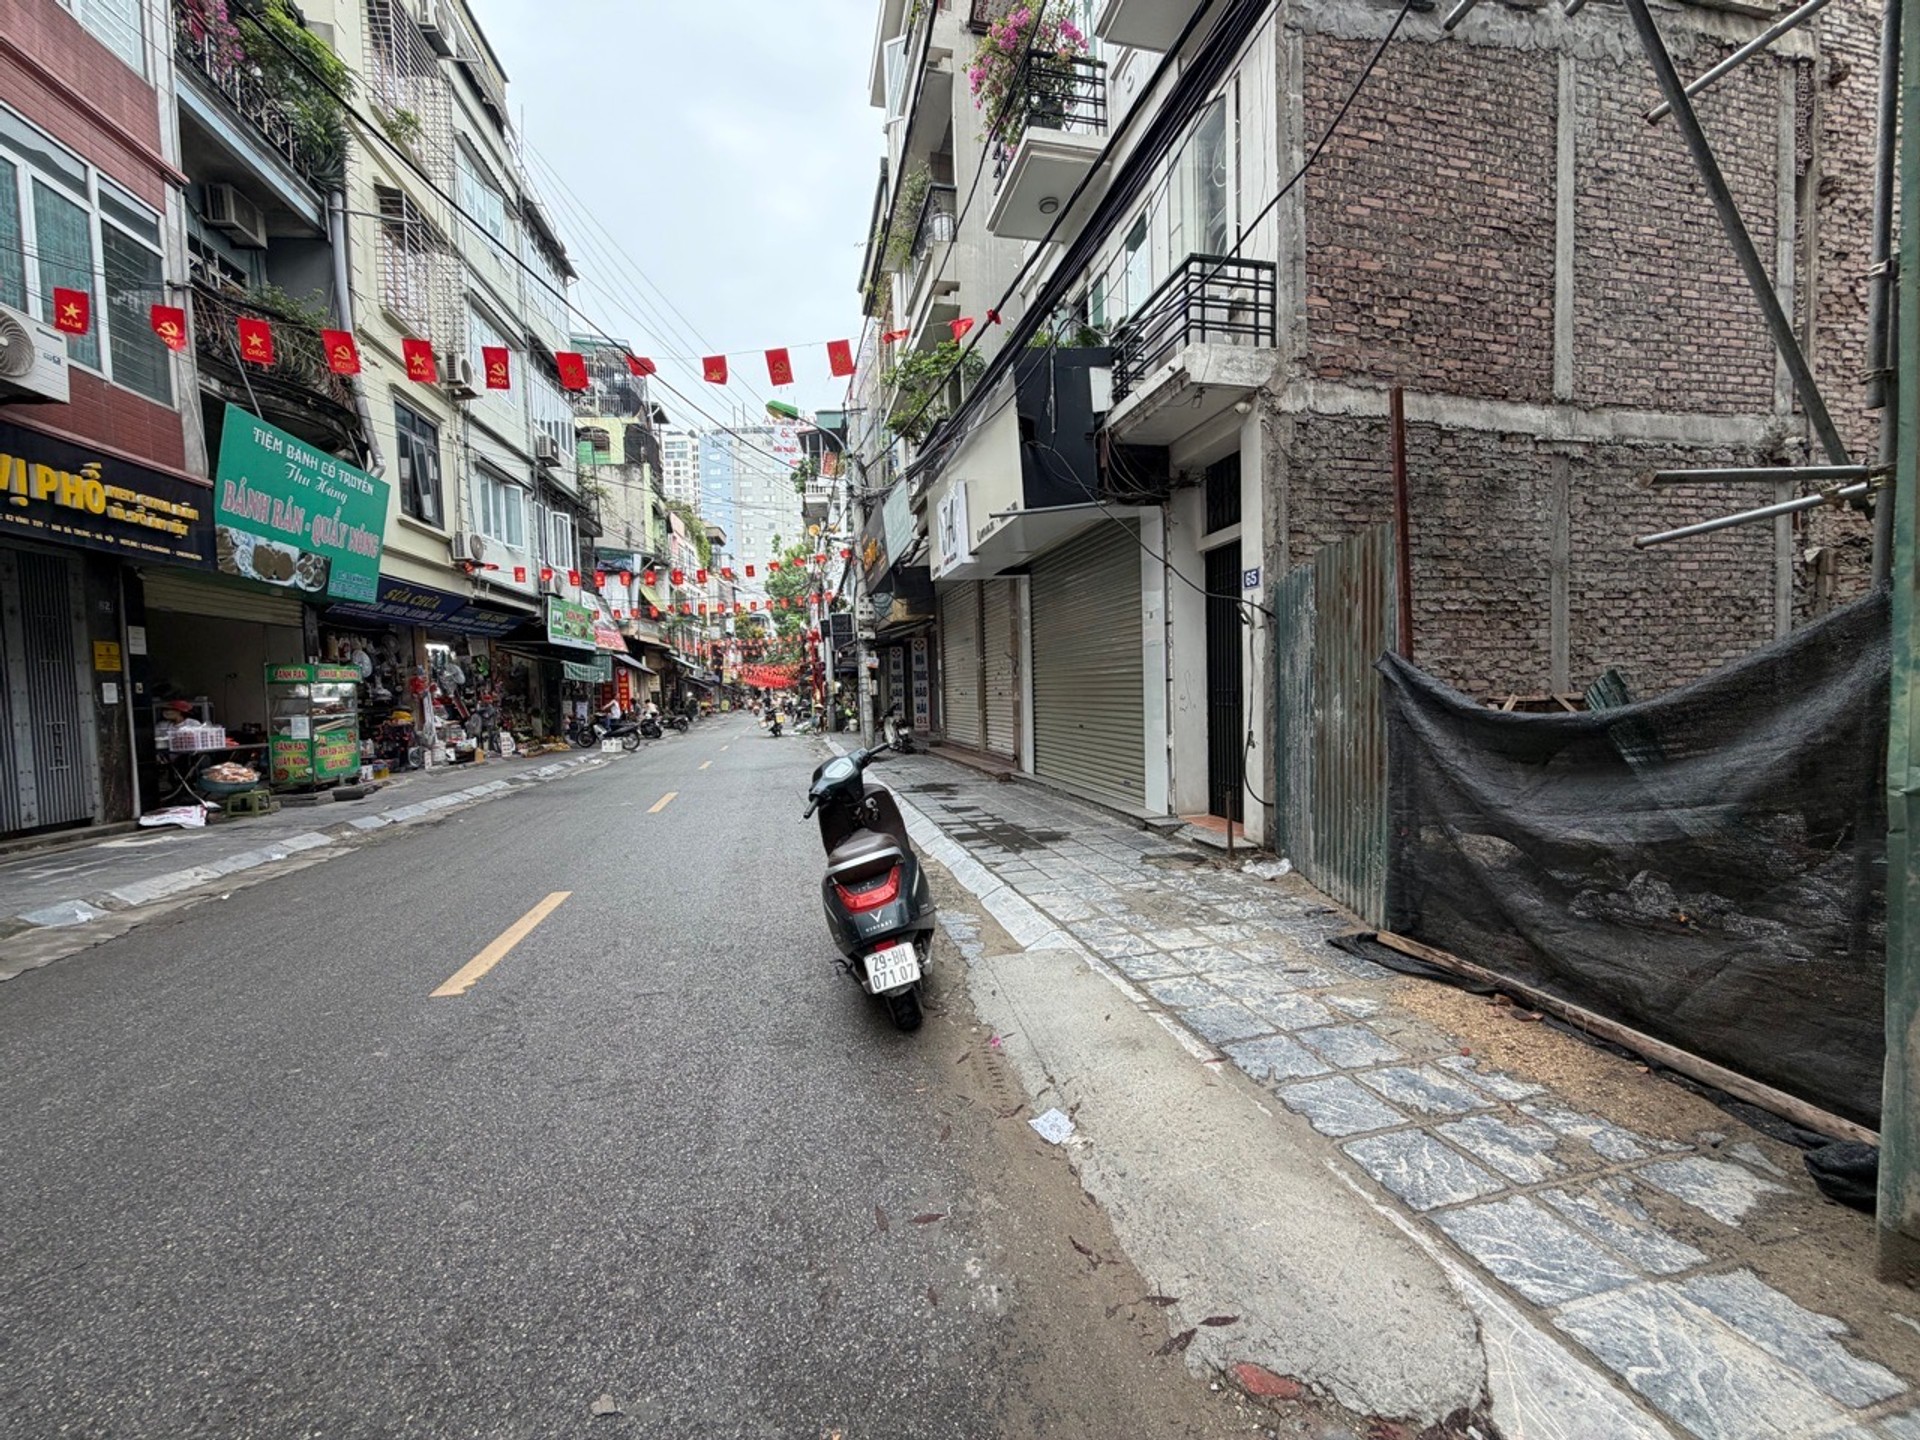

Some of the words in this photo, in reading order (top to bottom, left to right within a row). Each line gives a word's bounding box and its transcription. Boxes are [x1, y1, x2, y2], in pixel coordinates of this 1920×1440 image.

[253, 426, 283, 454] TIỆM
[284, 462, 310, 487] Thu
[221, 476, 272, 525] BÁNH
[271, 495, 306, 536] RÁN
[347, 522, 379, 559] NÓNG
[1245, 571, 1257, 586] 65
[872, 962, 914, 990] 071.07
